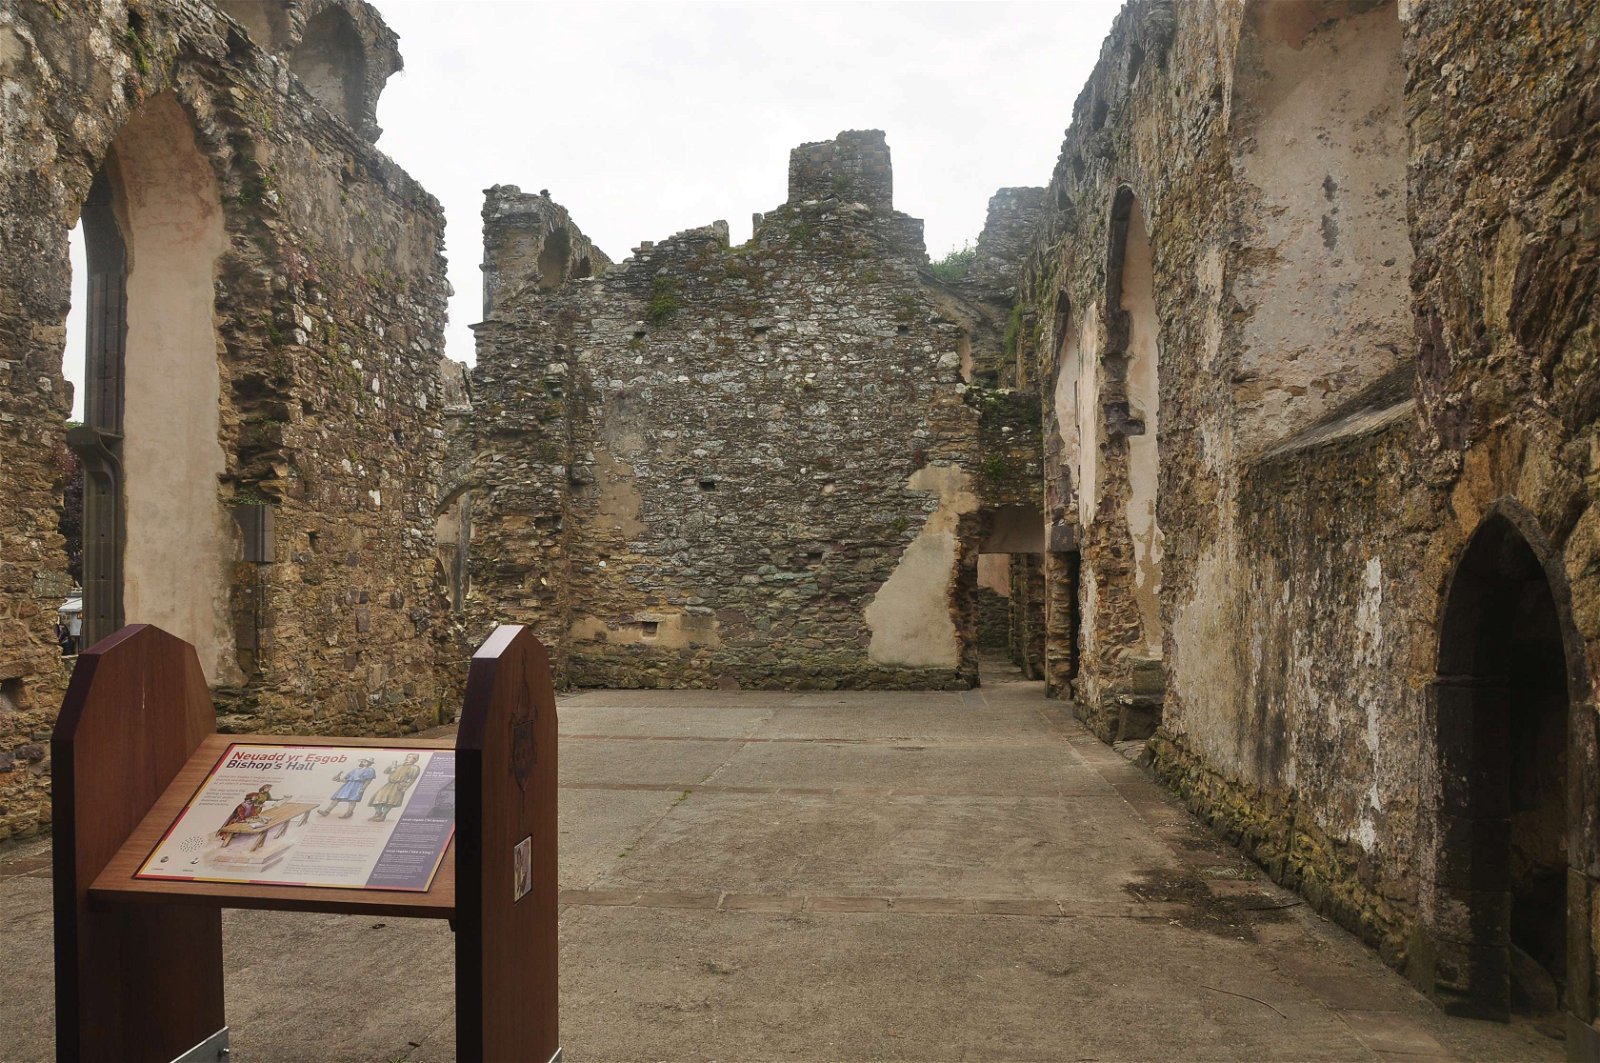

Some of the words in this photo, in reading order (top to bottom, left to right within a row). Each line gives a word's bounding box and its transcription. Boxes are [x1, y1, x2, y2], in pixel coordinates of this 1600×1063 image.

[232, 751, 286, 761] Neuadd
[285, 754, 302, 763] yr
[304, 753, 348, 764] Esgob
[226, 760, 282, 771] Bishop's
[286, 762, 315, 771] Hall
